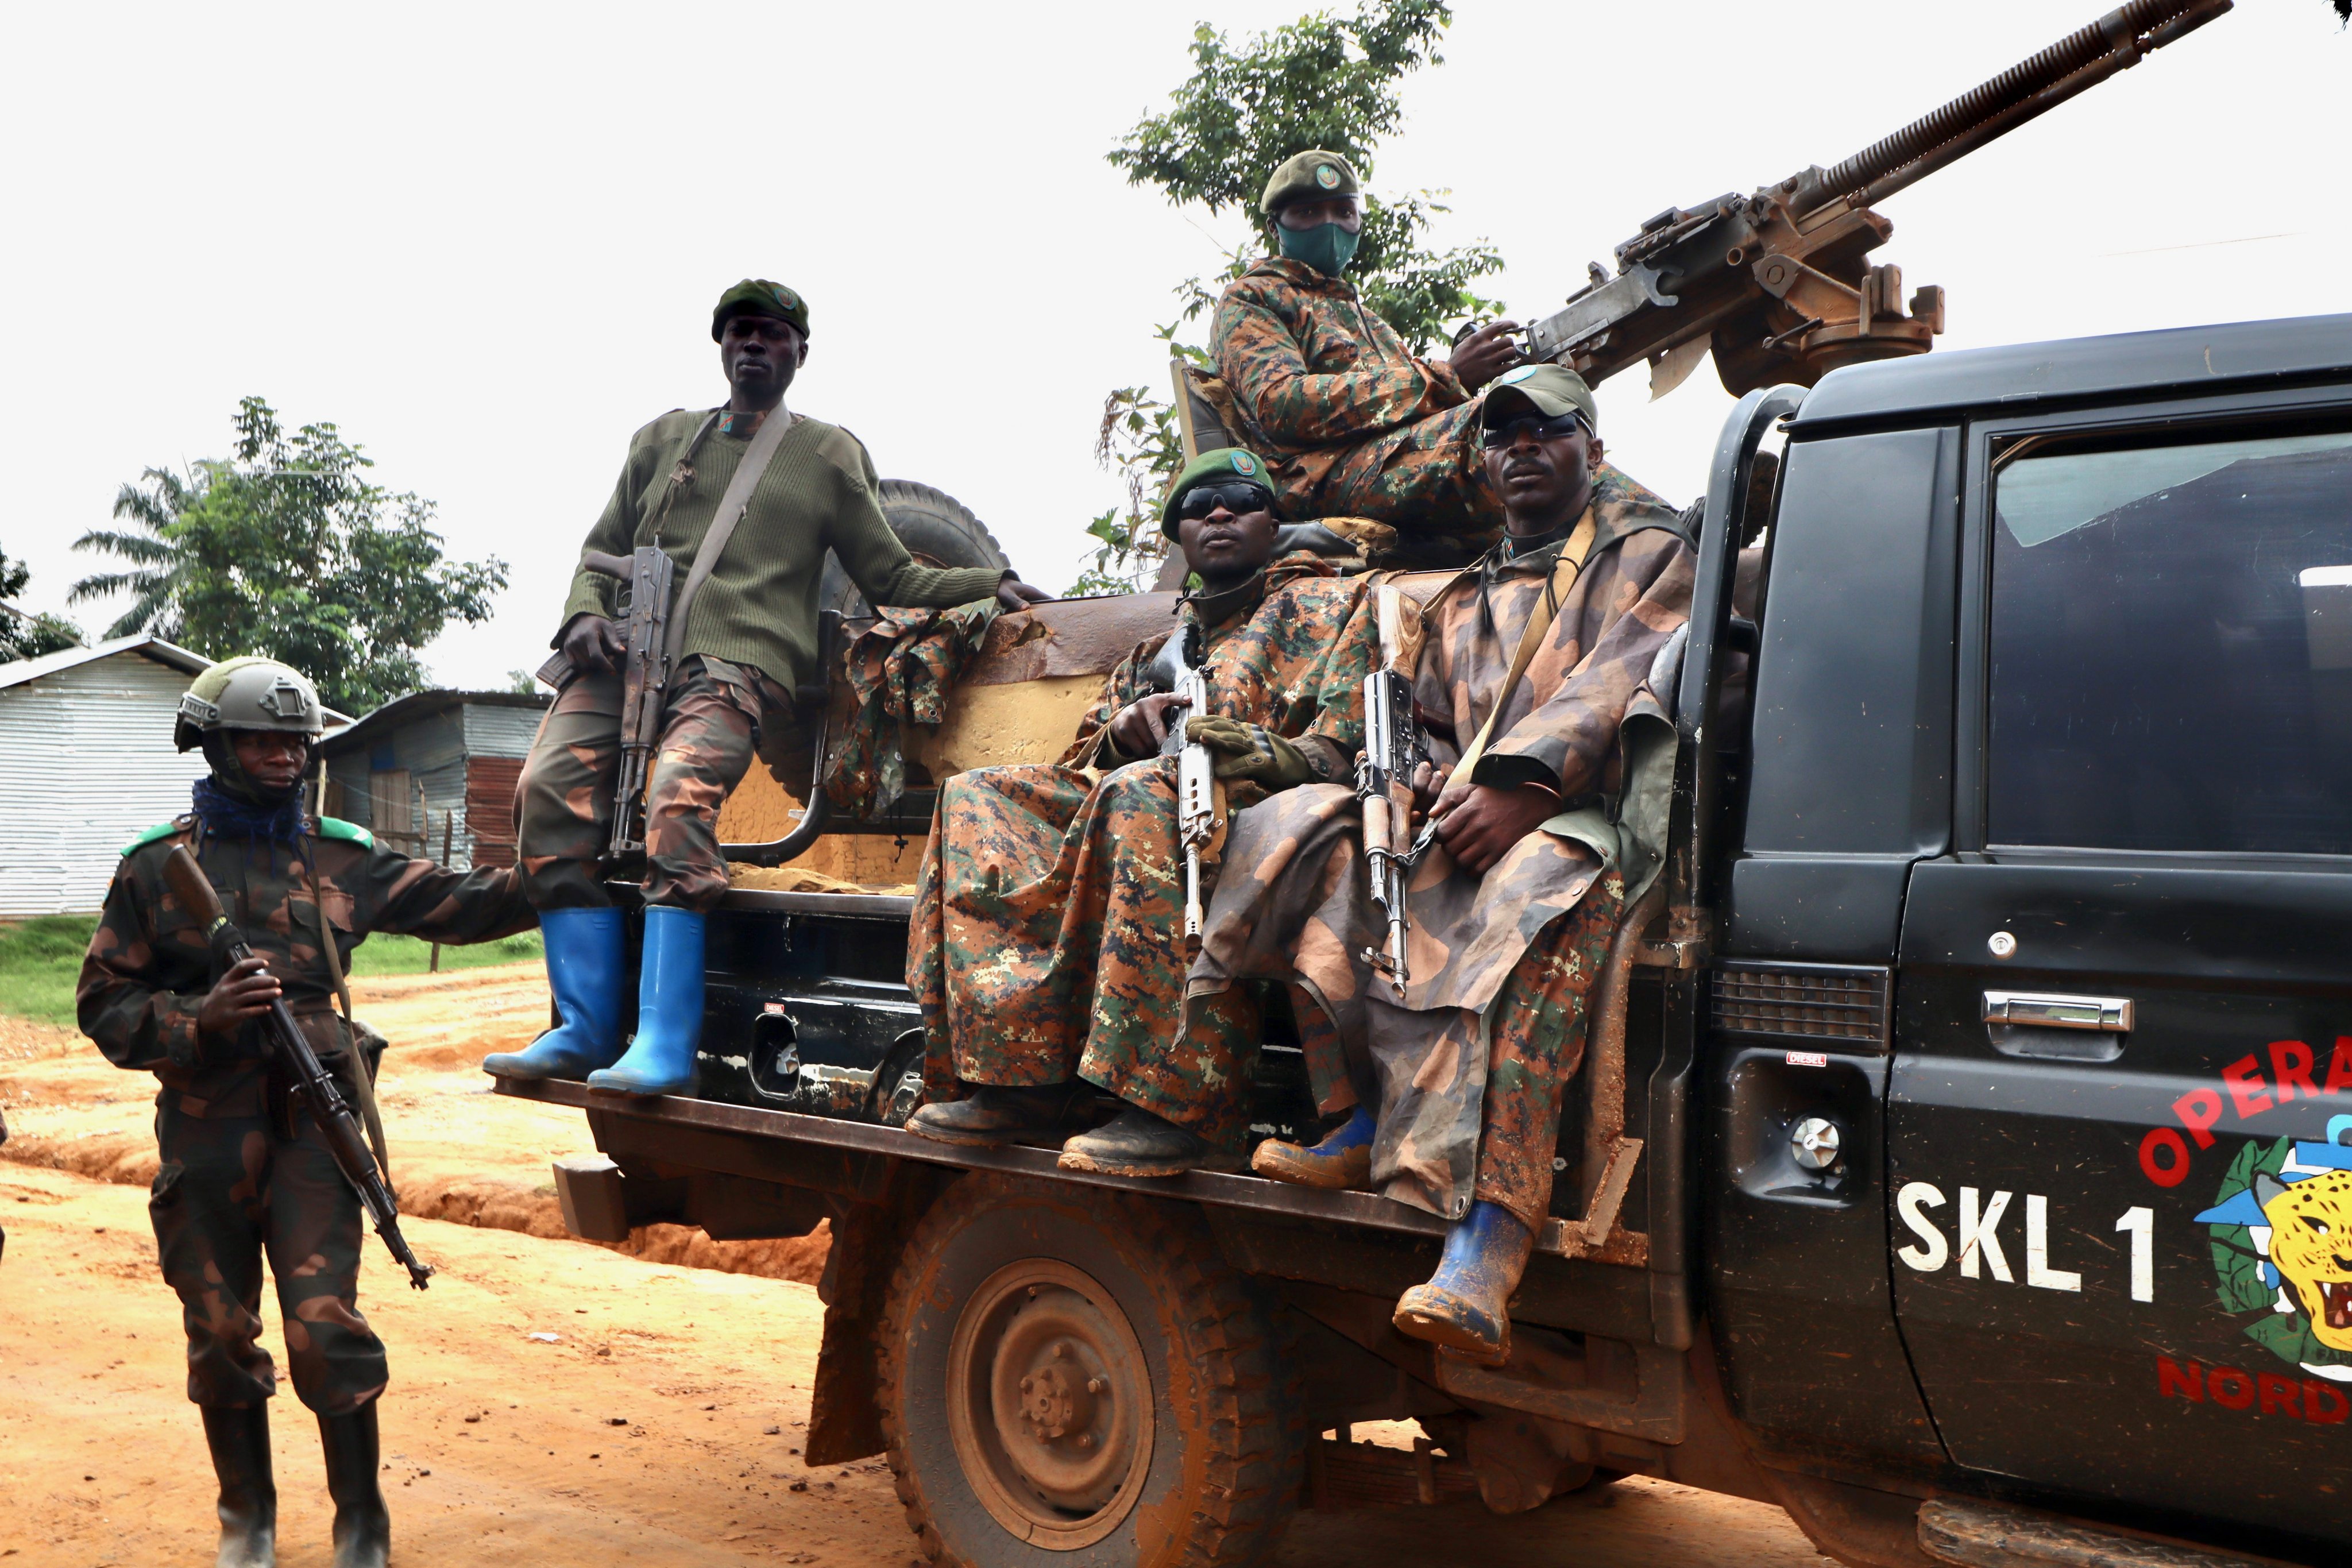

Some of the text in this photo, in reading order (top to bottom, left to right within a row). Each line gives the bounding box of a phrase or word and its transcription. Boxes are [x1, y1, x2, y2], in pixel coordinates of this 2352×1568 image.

[1789, 1053, 1824, 1064] DIESEL
[1897, 1182, 2153, 1303] SKL 1
[2157, 1355, 2350, 1424] NORD
